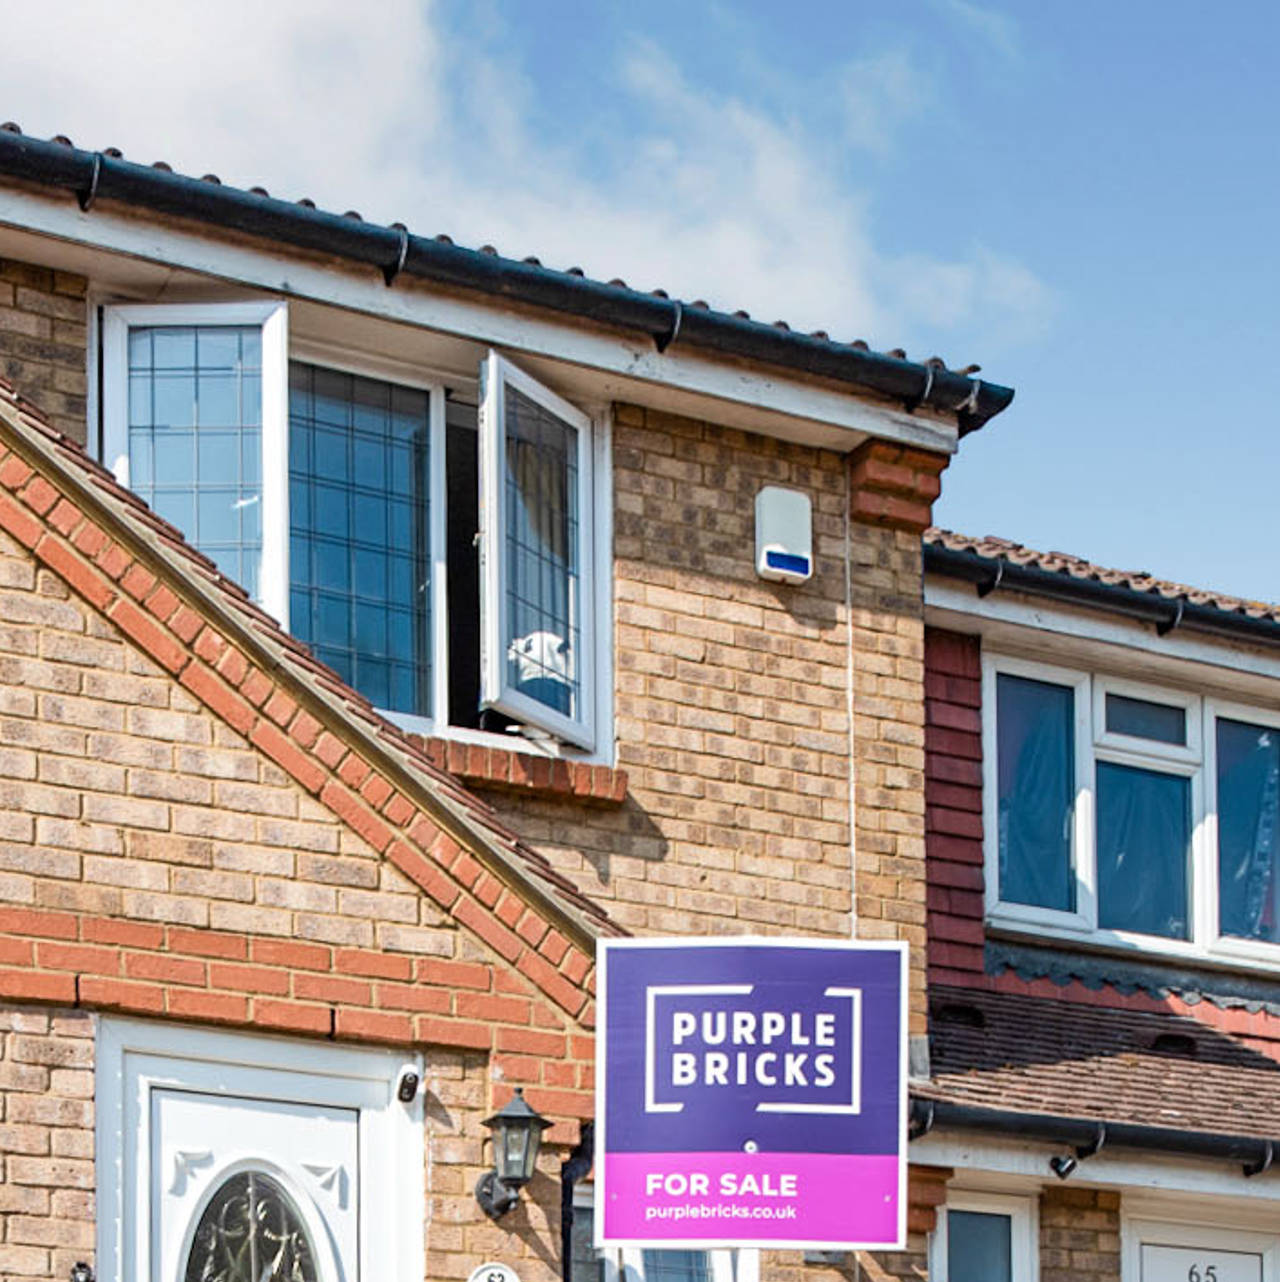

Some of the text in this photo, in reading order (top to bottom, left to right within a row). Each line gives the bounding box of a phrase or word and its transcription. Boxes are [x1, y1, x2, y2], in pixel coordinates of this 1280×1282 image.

[672, 1012, 835, 1046] PURPLE
[672, 1052, 835, 1087] BRICKS
[645, 1172, 798, 1197] FOR SALE
[644, 1203, 796, 1220] purplebricks.co.uk
